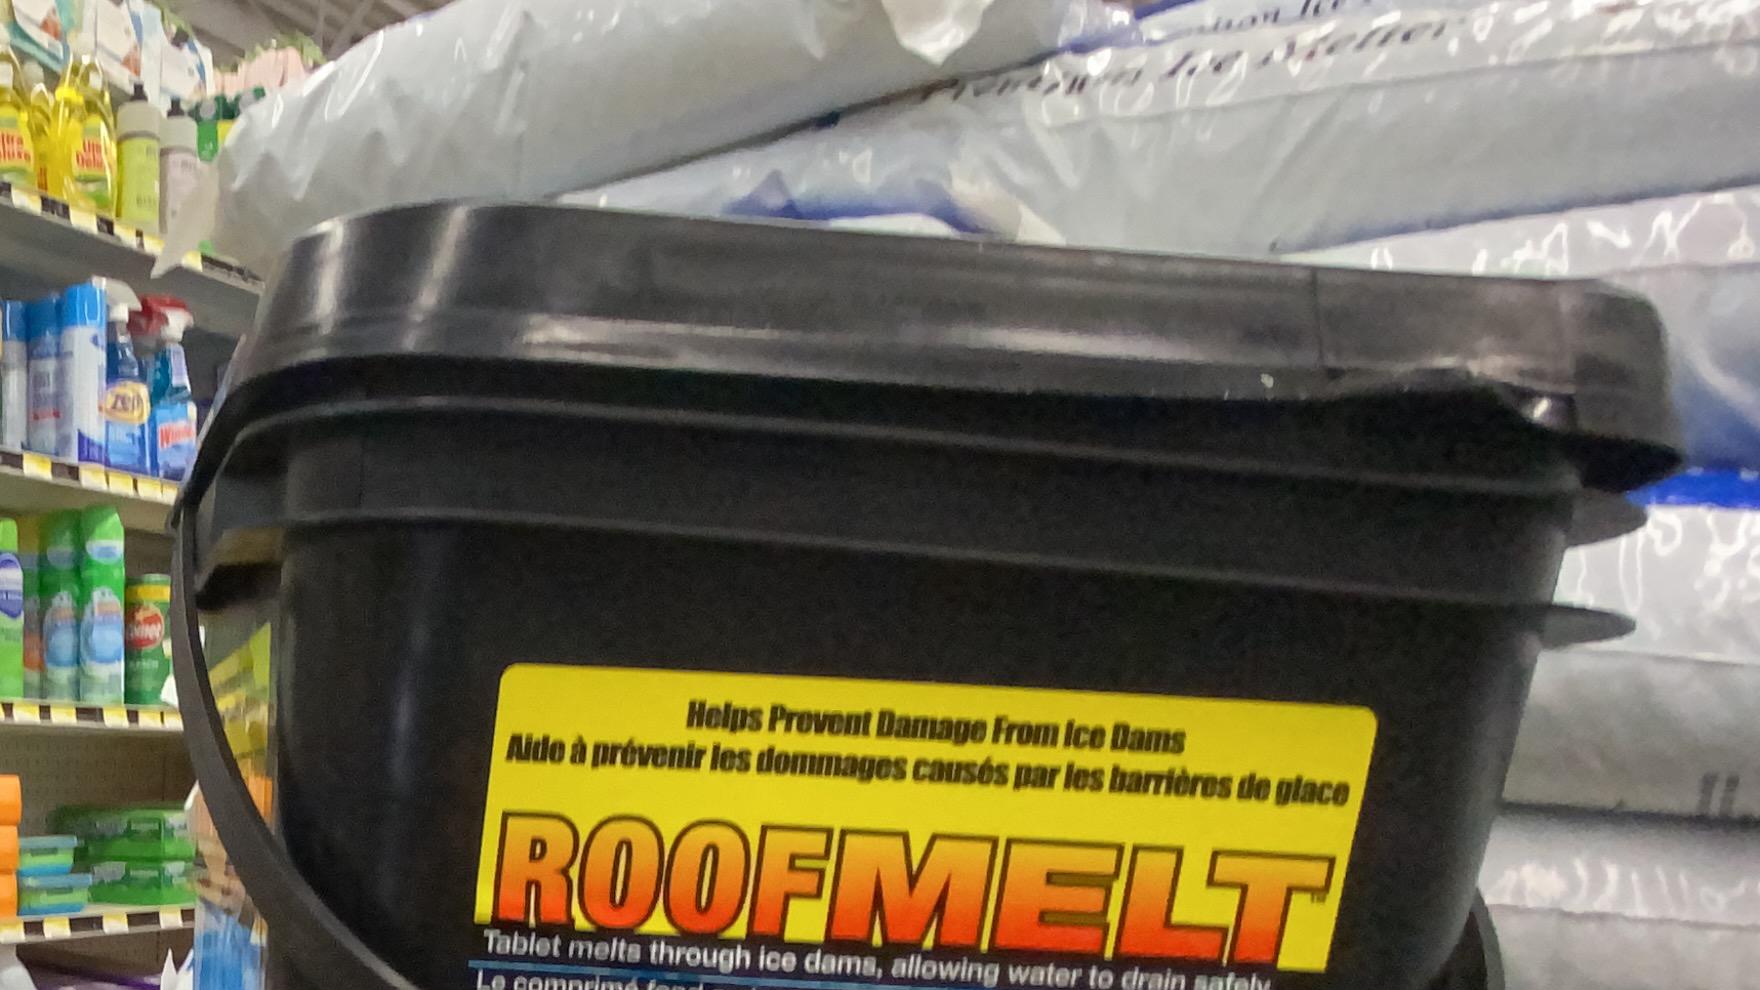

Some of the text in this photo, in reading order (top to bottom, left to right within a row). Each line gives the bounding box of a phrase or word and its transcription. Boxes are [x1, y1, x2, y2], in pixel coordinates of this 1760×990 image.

[686, 699, 1187, 755] Helps Prevent Damage From Ice Dams
[506, 733, 1351, 808] Aide à prévenir les dommages causés par les barrières de glace
[494, 810, 1336, 964] ROOFMELT
[484, 928, 561, 958] Tablet
[568, 933, 642, 964] melts
[649, 939, 752, 974] through
[758, 945, 797, 973] ice
[804, 949, 883, 979] dams,
[891, 953, 1000, 988] allowing
[1008, 963, 1083, 989] water
[1088, 963, 1115, 989] to
